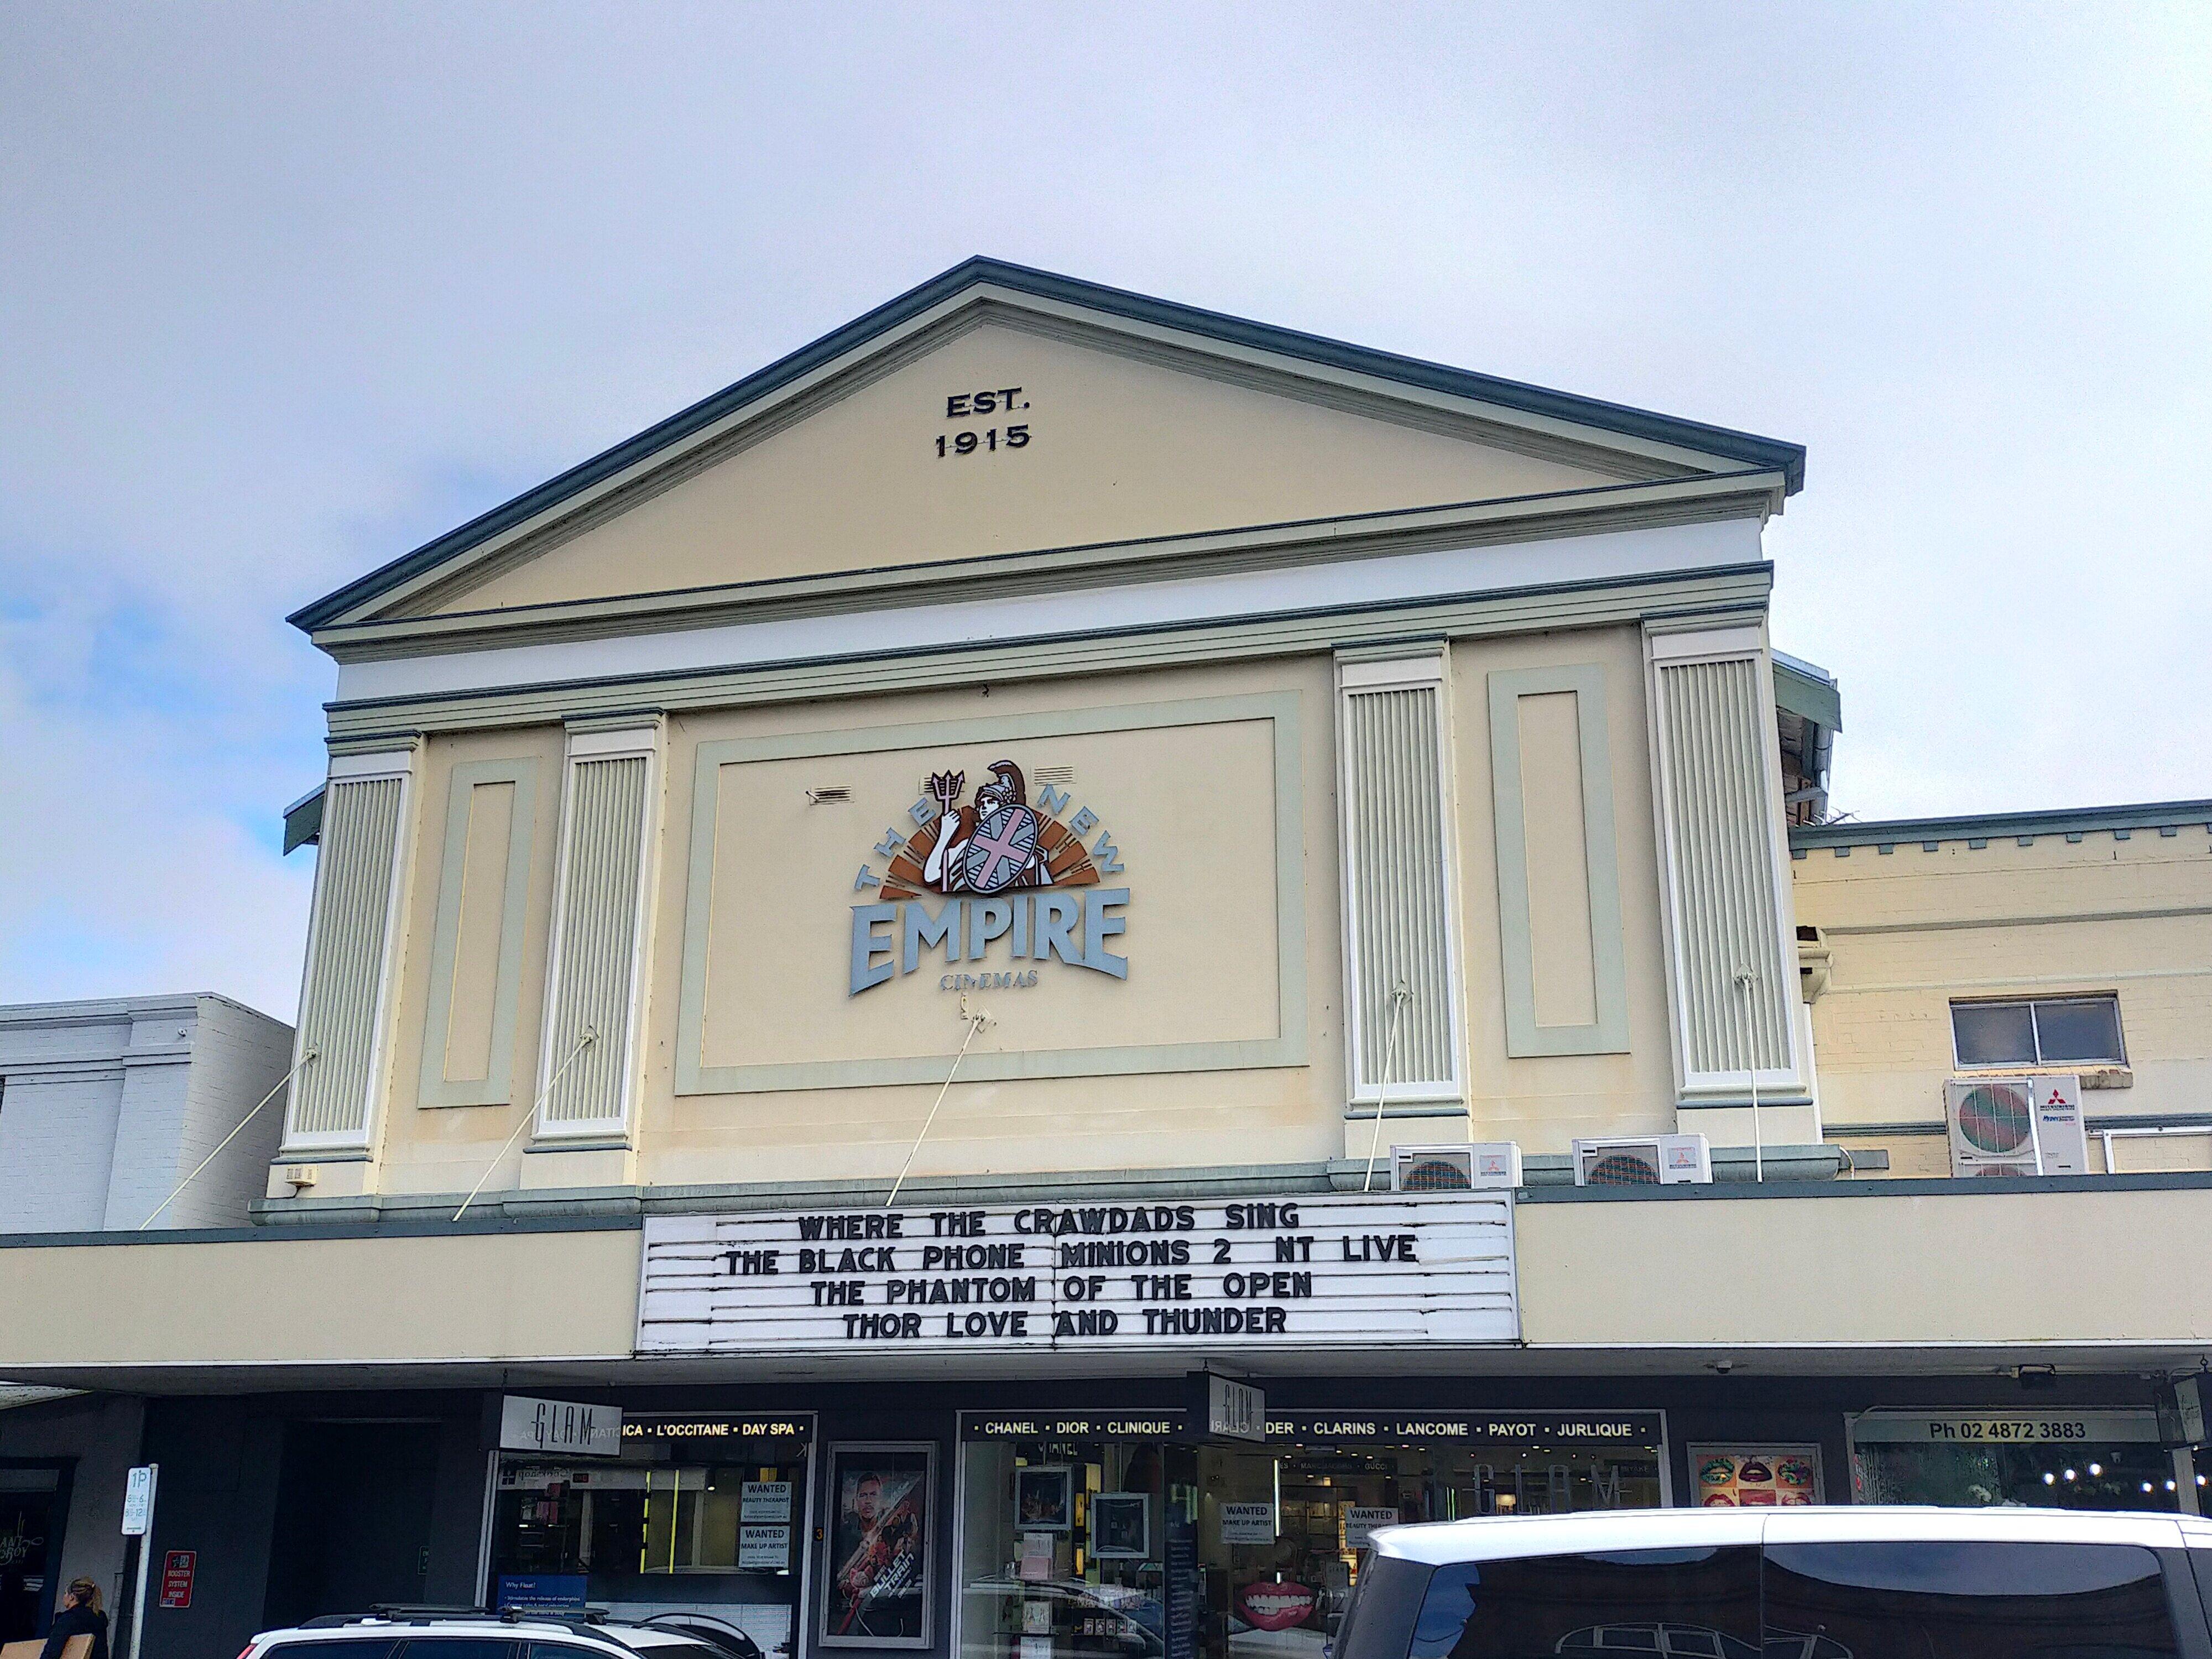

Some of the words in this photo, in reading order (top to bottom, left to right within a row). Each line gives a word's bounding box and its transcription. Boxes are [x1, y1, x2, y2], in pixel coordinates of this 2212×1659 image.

[946, 387, 1030, 417] EST.
[936, 424, 1030, 458] 1915
[1037, 784, 1124, 872] NEW
[854, 797, 936, 890] THE
[848, 888, 1130, 997] EMPIRE
[940, 969, 1038, 991] CINEMAS
[799, 1214, 904, 1240] WHERE
[930, 1211, 985, 1238] THE
[1015, 1206, 1194, 1234] CRAWDADS
[1226, 1203, 1299, 1229] SING
[726, 1250, 779, 1275] THE
[799, 1247, 896, 1272] BLACK
[923, 1243, 1024, 1271] PHONE
[1061, 1240, 1190, 1267] MINIONS
[1214, 1239, 1231, 1264] 2
[1276, 1236, 1314, 1262] NT
[1343, 1234, 1416, 1262] LIVE
[810, 1281, 865, 1306] THE
[887, 1276, 1035, 1304] PHANTOM
[1063, 1275, 1105, 1301] OF
[1131, 1274, 1192, 1300] THE
[1223, 1272, 1312, 1298] OPEN
[843, 1313, 921, 1339] THOR
[946, 1311, 1028, 1337] LOVE
[1055, 1309, 1118, 1337] AND
[1142, 1307, 1286, 1335] THUNDER
[531, 1403, 596, 1448] GLAM
[656, 1424, 729, 1436] L'OCCITANE
[743, 1423, 768, 1435] DAY
[770, 1423, 795, 1435] SPA
[985, 1422, 1038, 1434] CHANEL
[1056, 1422, 1089, 1434] DIOR
[1107, 1421, 1171, 1434] CLINIQUE
[1313, 1422, 1376, 1435] CLARINS
[1396, 1423, 1468, 1436] LANCOME
[1489, 1423, 1536, 1436] PAYOT
[1557, 1423, 1632, 1437] JURLIQUE
[1930, 1423, 1955, 1438] Ph
[1960, 1422, 1984, 1439] 02
[1988, 1423, 2034, 1438] 4872
[2040, 1422, 2086, 1438] 3883
[748, 1484, 786, 1493] WANTED
[1226, 1506, 1267, 1516] WANTED
[1350, 1510, 1392, 1520] WANTED
[745, 1530, 785, 1538] WANTED
[816, 1528, 823, 1540] 3
[505, 1582, 519, 1590] Why
